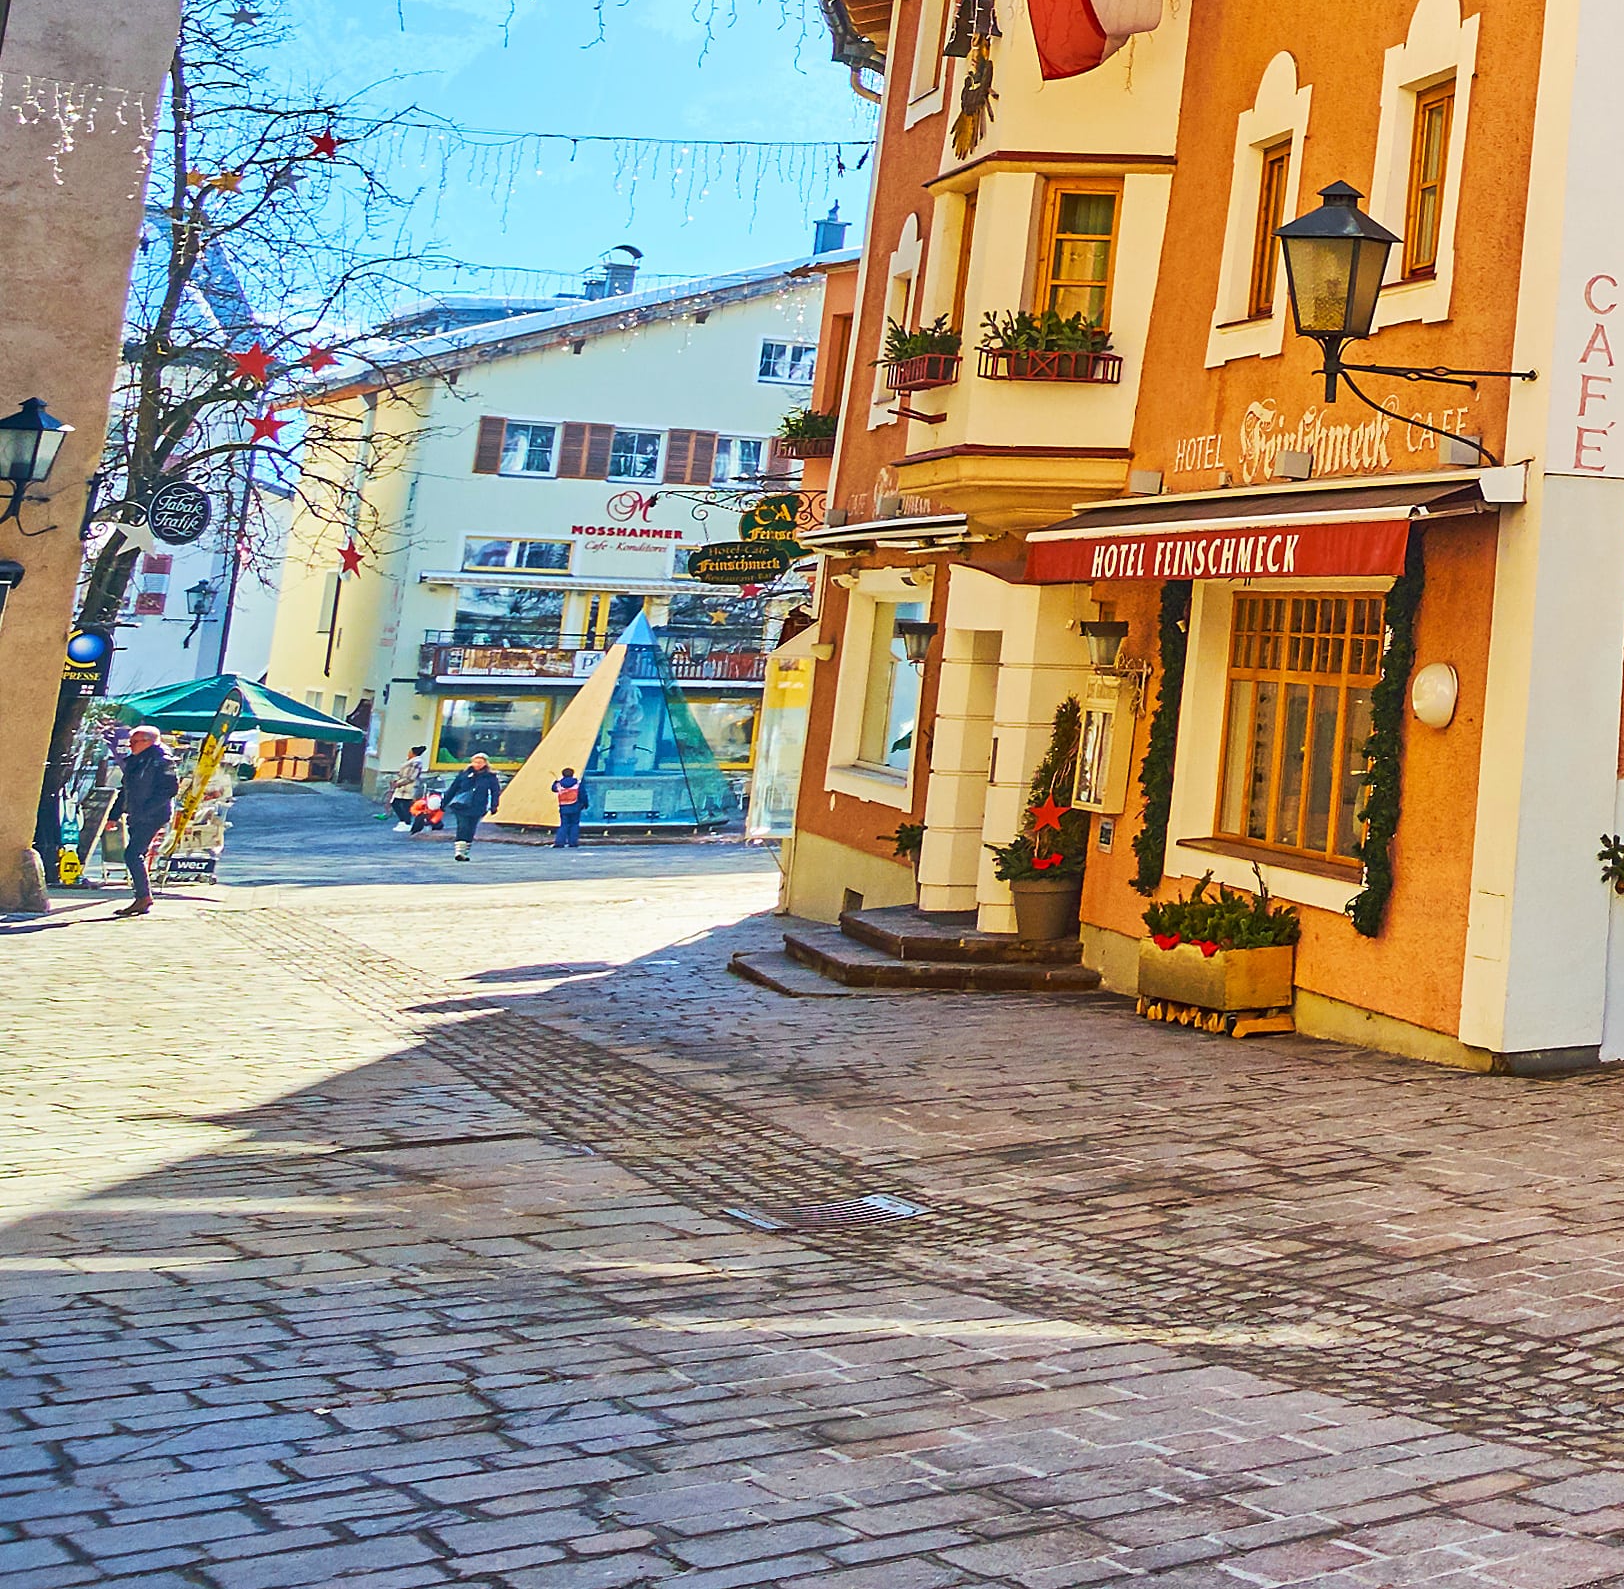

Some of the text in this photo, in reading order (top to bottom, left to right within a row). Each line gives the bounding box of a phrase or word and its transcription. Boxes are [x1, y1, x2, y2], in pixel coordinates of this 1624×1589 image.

[1173, 434, 1225, 474] HOTEL
[156, 495, 208, 516] Tabak
[153, 511, 204, 531] Trafik
[571, 525, 684, 540] MOSSHAMMER
[695, 557, 781, 573] Feinschmeck
[1090, 534, 1300, 578] HOTEL FEINSCHMECK
[63, 671, 101, 681] PRESSE
